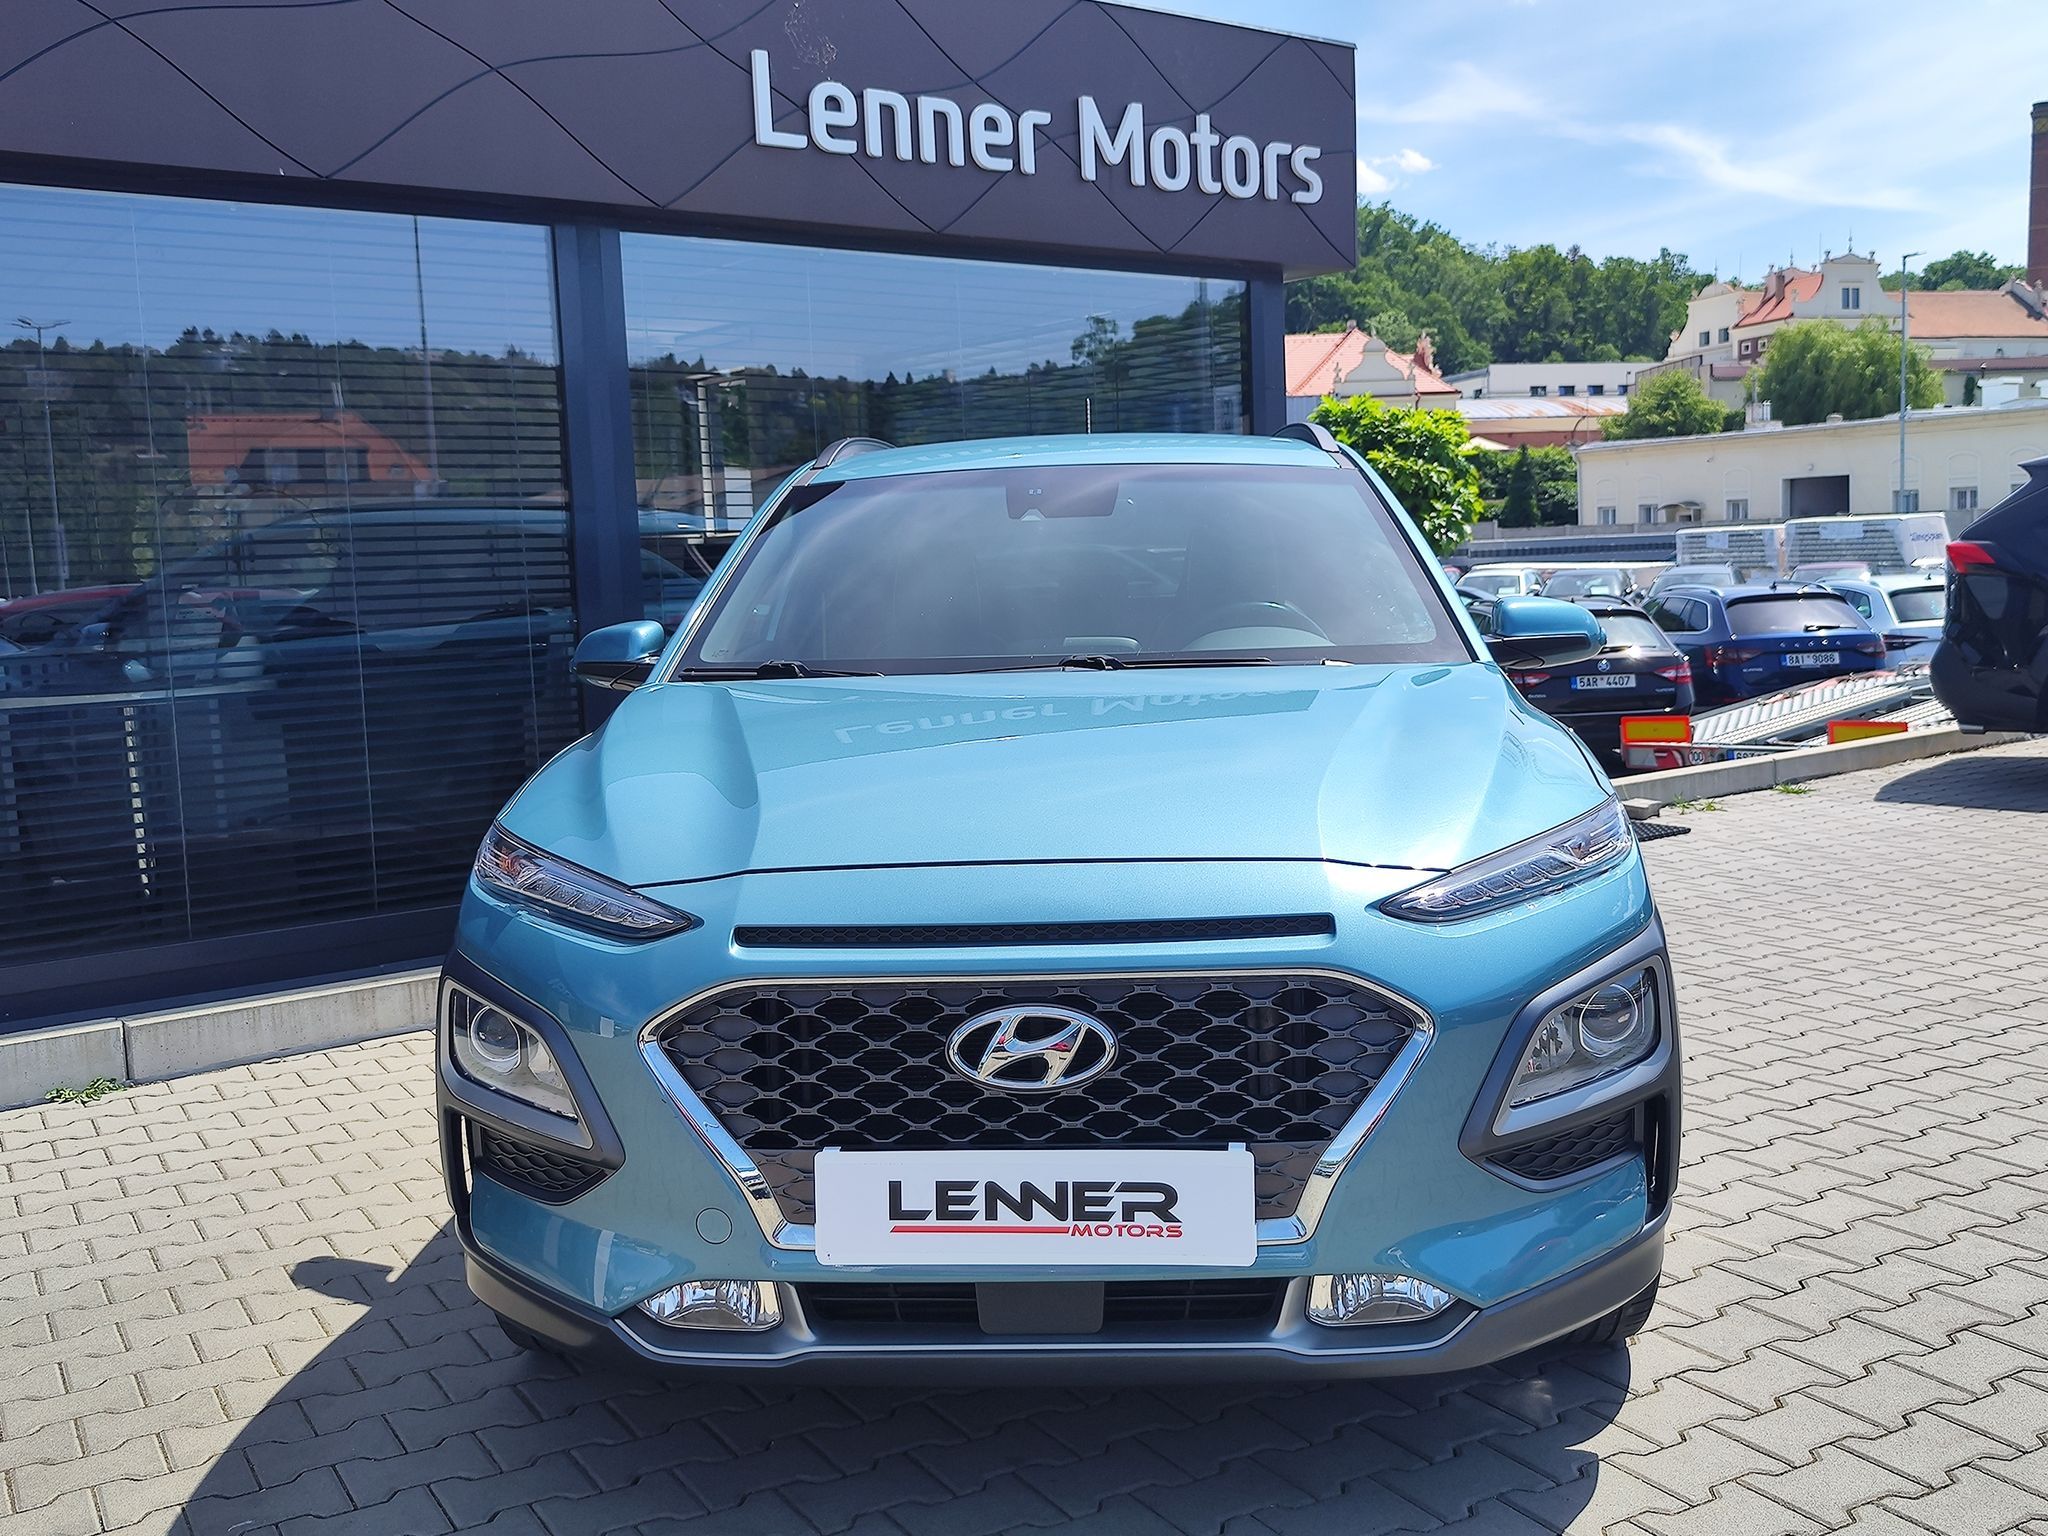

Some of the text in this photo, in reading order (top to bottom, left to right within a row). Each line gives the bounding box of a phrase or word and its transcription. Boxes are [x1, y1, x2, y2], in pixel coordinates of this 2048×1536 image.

[750, 49, 1324, 205] Lenner Motors
[1578, 675, 1630, 688] 5AR 4407
[887, 1180, 1182, 1222] LENNER
[1070, 1224, 1183, 1239] MOTORS
